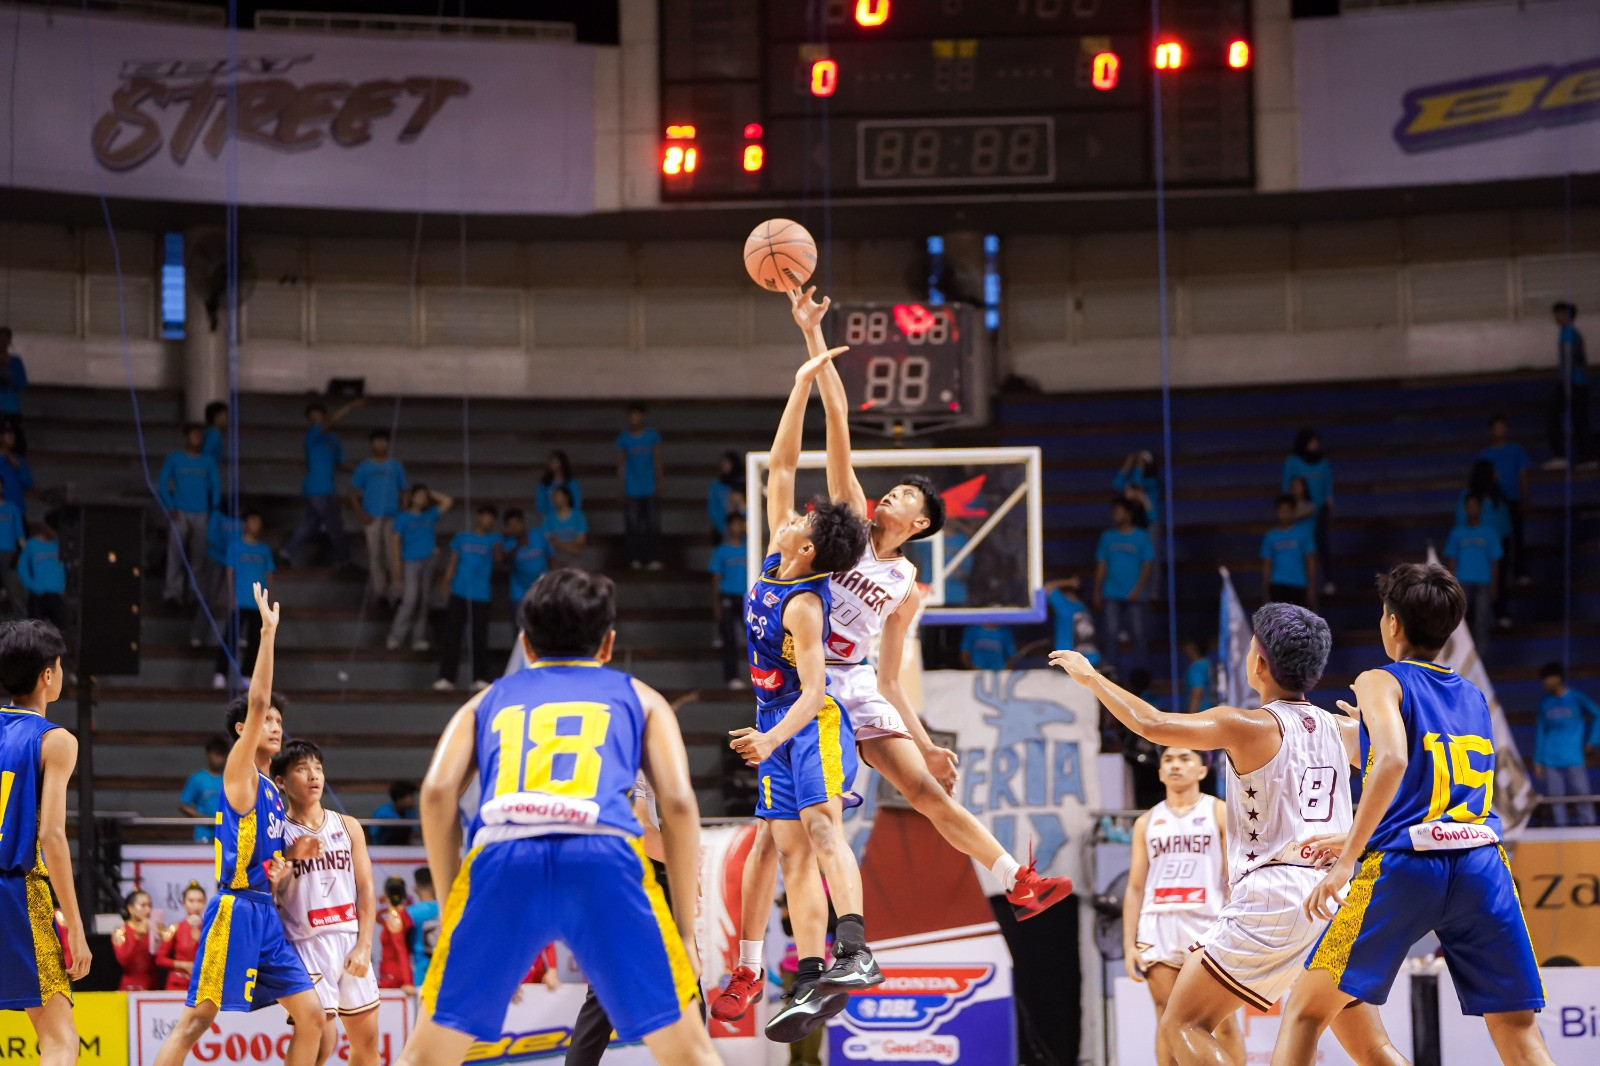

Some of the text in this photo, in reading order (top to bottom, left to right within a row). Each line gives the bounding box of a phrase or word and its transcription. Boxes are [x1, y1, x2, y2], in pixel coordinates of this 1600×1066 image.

[811, 59, 838, 97] 0
[92, 75, 471, 172] STREET
[491, 701, 611, 799] 18
[761, 775, 772, 809] 1
[1299, 766, 1338, 822] 8
[1423, 731, 1494, 825] 15
[320, 876, 337, 898] 7
[191, 1021, 391, 1066] Gooday
[1560, 1006, 1600, 1037] Bi
